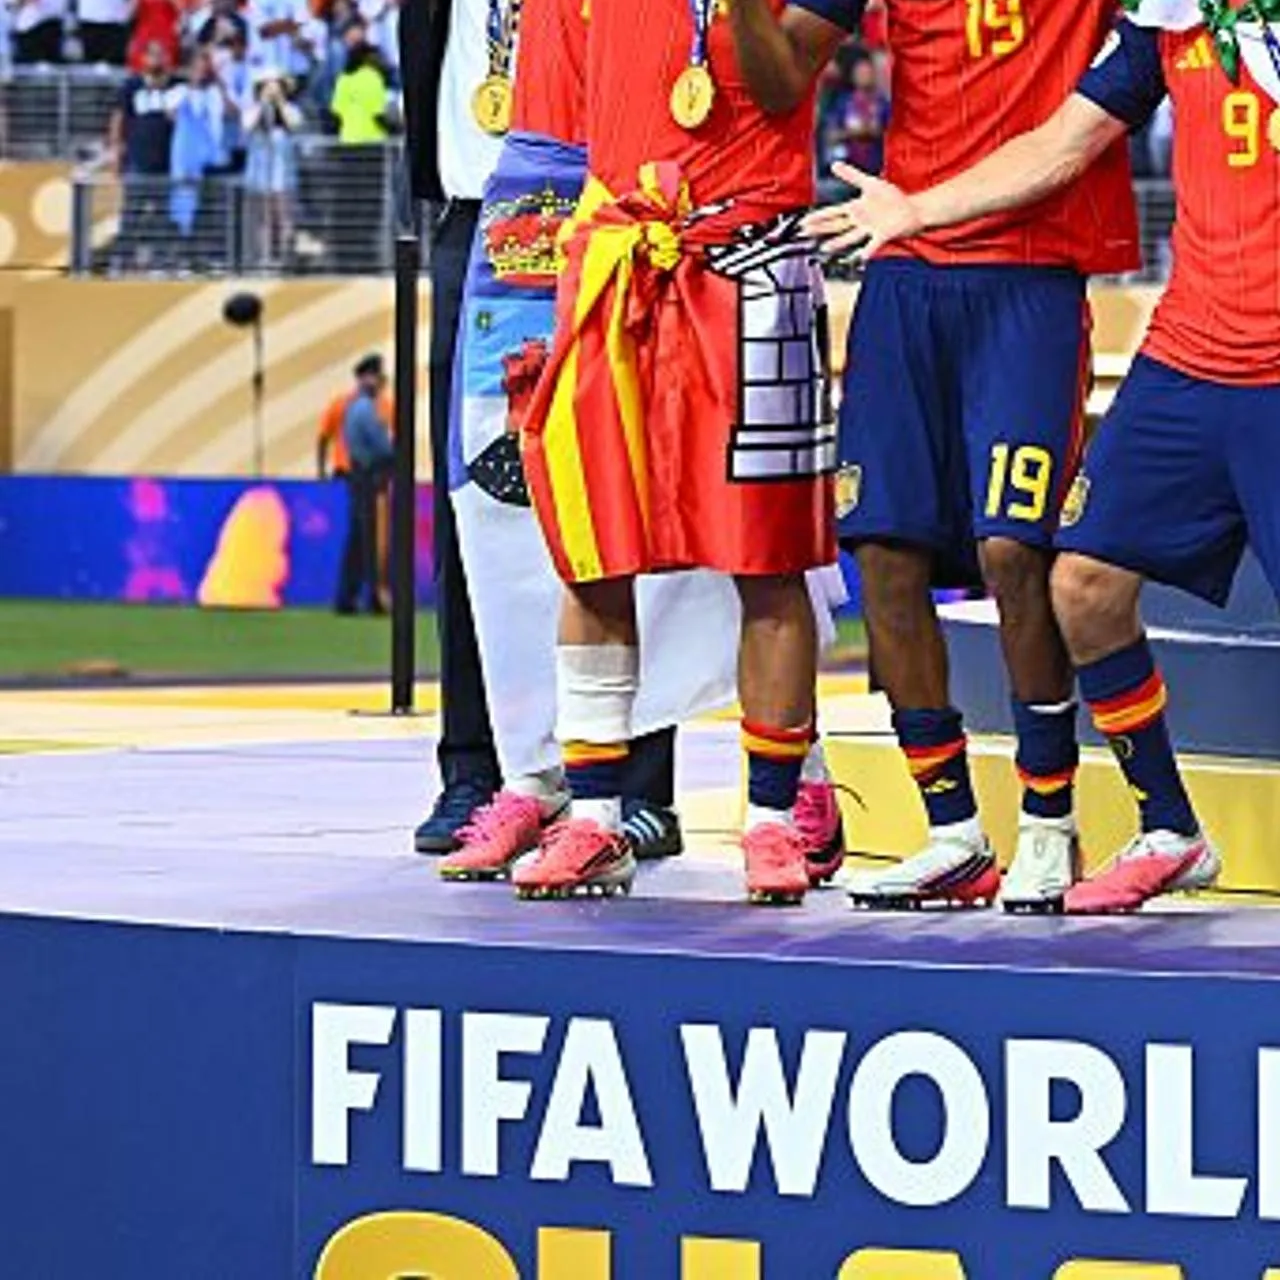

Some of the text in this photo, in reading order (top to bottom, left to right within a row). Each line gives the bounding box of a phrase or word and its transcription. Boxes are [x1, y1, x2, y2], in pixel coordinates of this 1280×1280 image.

[1222, 91, 1259, 167] 9
[984, 442, 1051, 522] 19
[312, 1003, 653, 1188] FIFA
